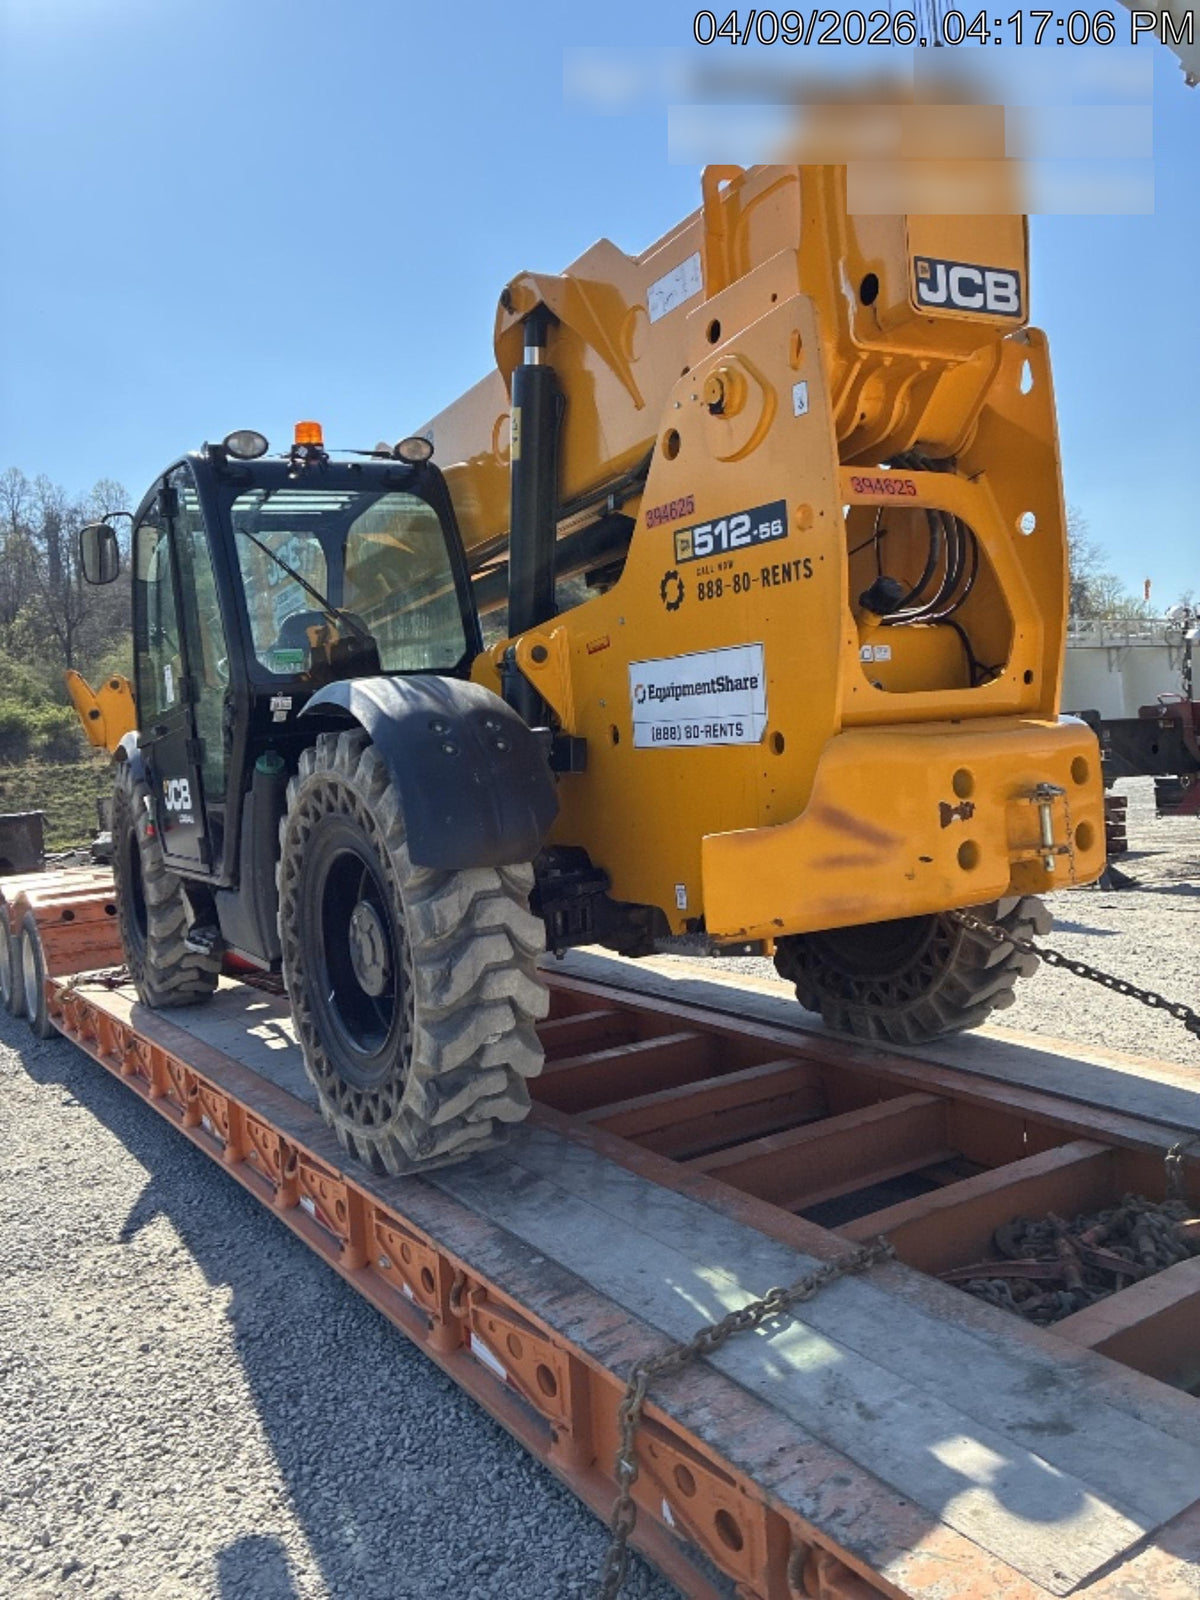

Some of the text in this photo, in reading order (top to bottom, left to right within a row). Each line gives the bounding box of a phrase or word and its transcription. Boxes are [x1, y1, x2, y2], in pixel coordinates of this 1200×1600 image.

[918, 263, 1020, 312] JCB
[850, 476, 917, 496] 394625
[646, 494, 694, 529] 394625
[697, 557, 814, 601] 888-80-RENTS
[648, 675, 759, 702] EquipmentShare
[652, 721, 744, 742] (888) 80-RENTS
[164, 778, 192, 811] JCB
